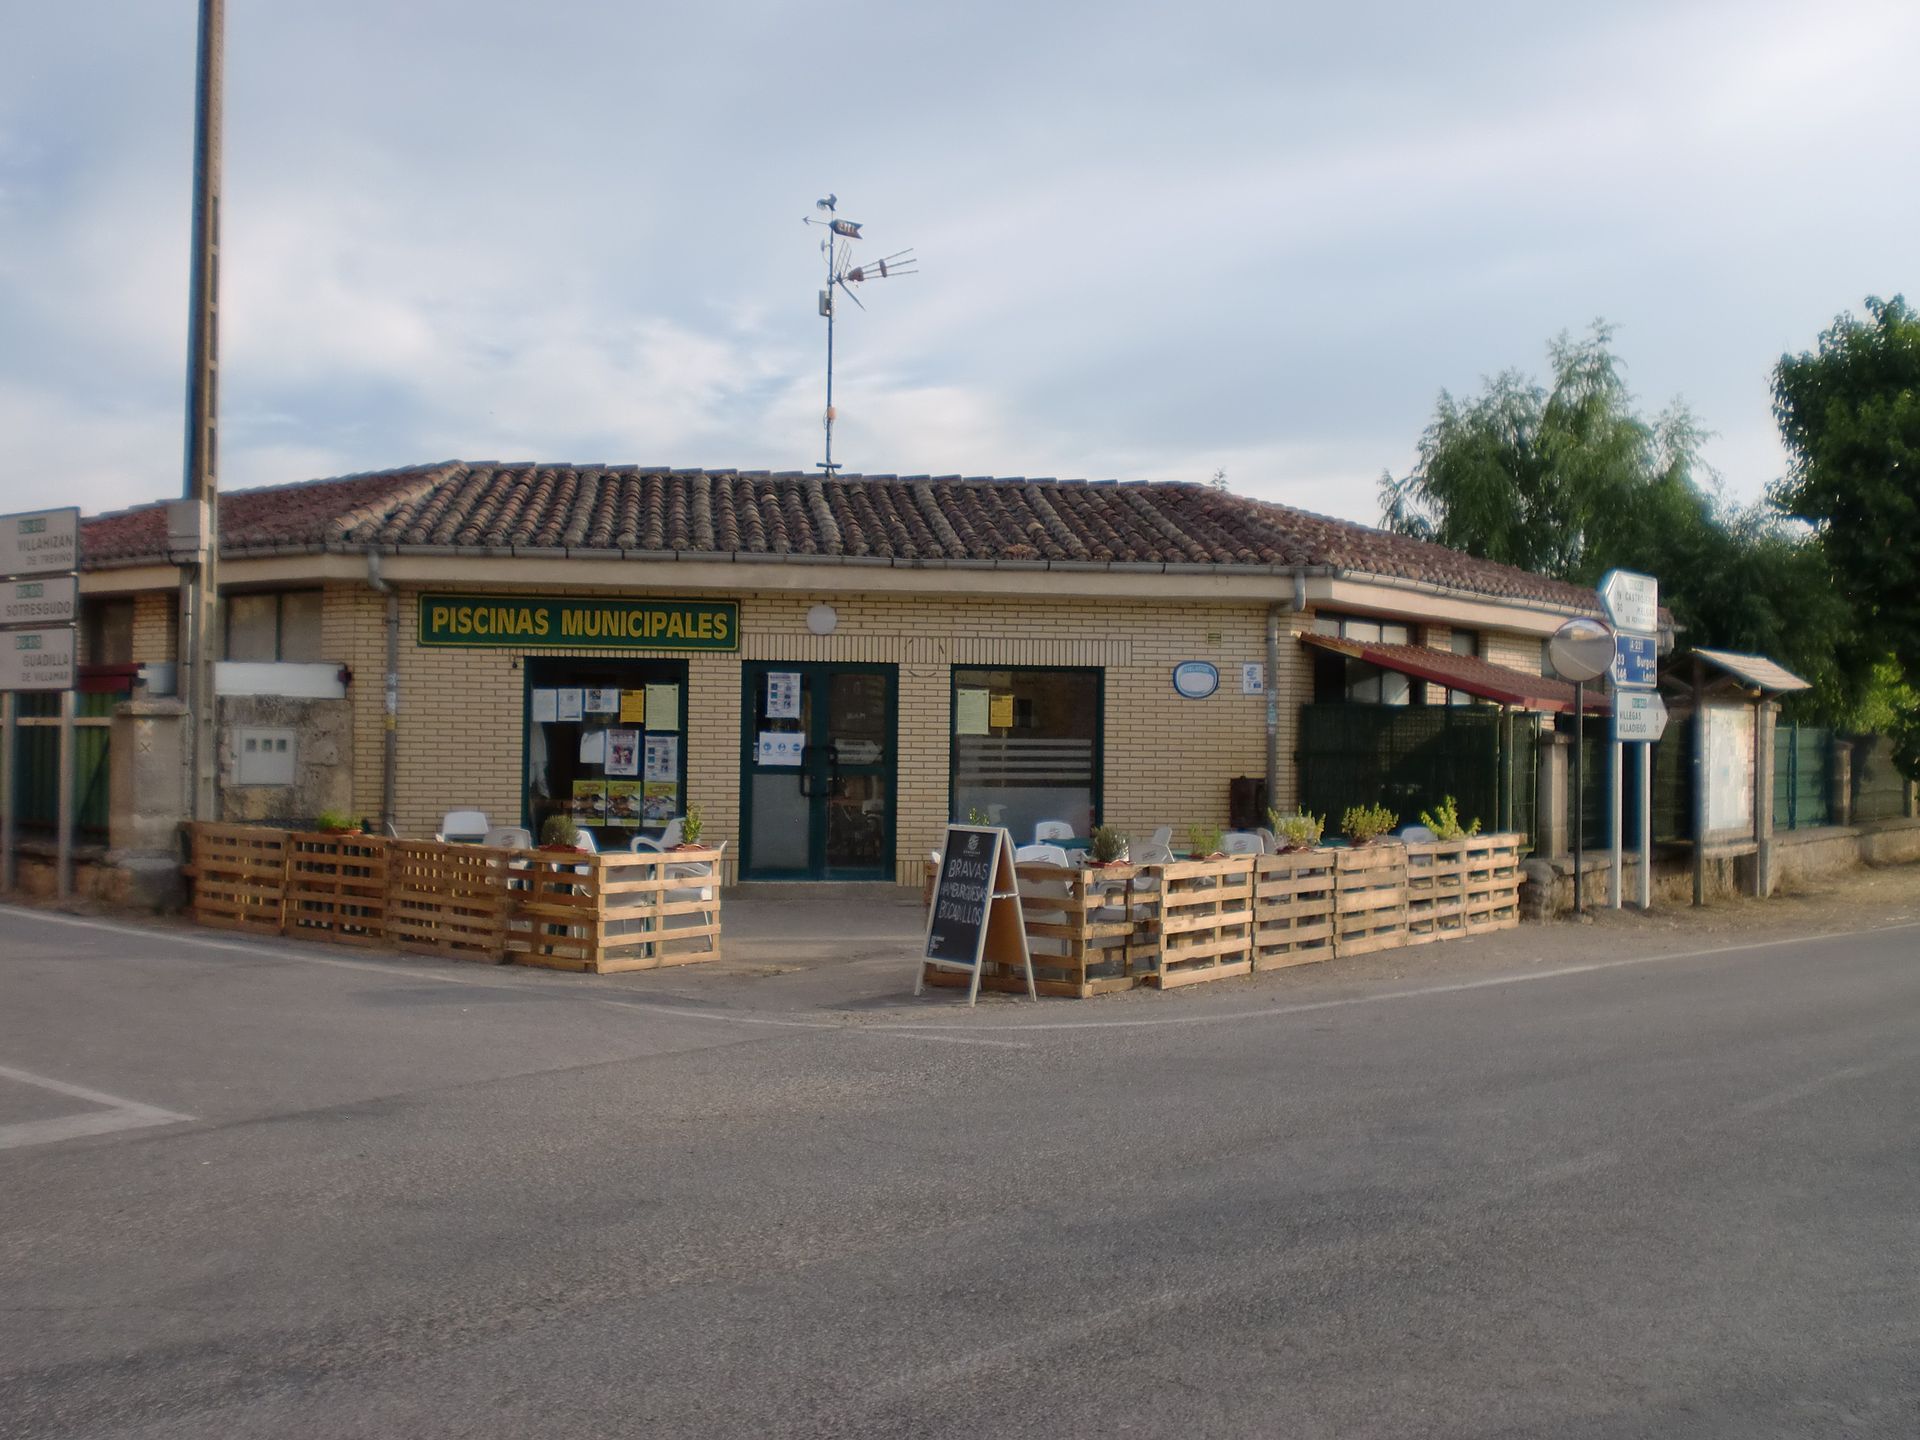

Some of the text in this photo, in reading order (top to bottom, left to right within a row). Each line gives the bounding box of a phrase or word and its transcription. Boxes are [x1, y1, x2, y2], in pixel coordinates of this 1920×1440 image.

[6, 600, 71, 617] SOTRESGUDO
[432, 607, 728, 640] PISCINAS MUNICIPALES
[23, 653, 69, 667] GUADILLA
[1636, 655, 1655, 670] Burgos
[22, 672, 31, 682] DE
[1619, 711, 1642, 720] VILLEGAS
[948, 858, 989, 881] BRAVAS
[940, 881, 987, 903] HAMBURGUESAS
[938, 899, 983, 926] BOCADILLOS
